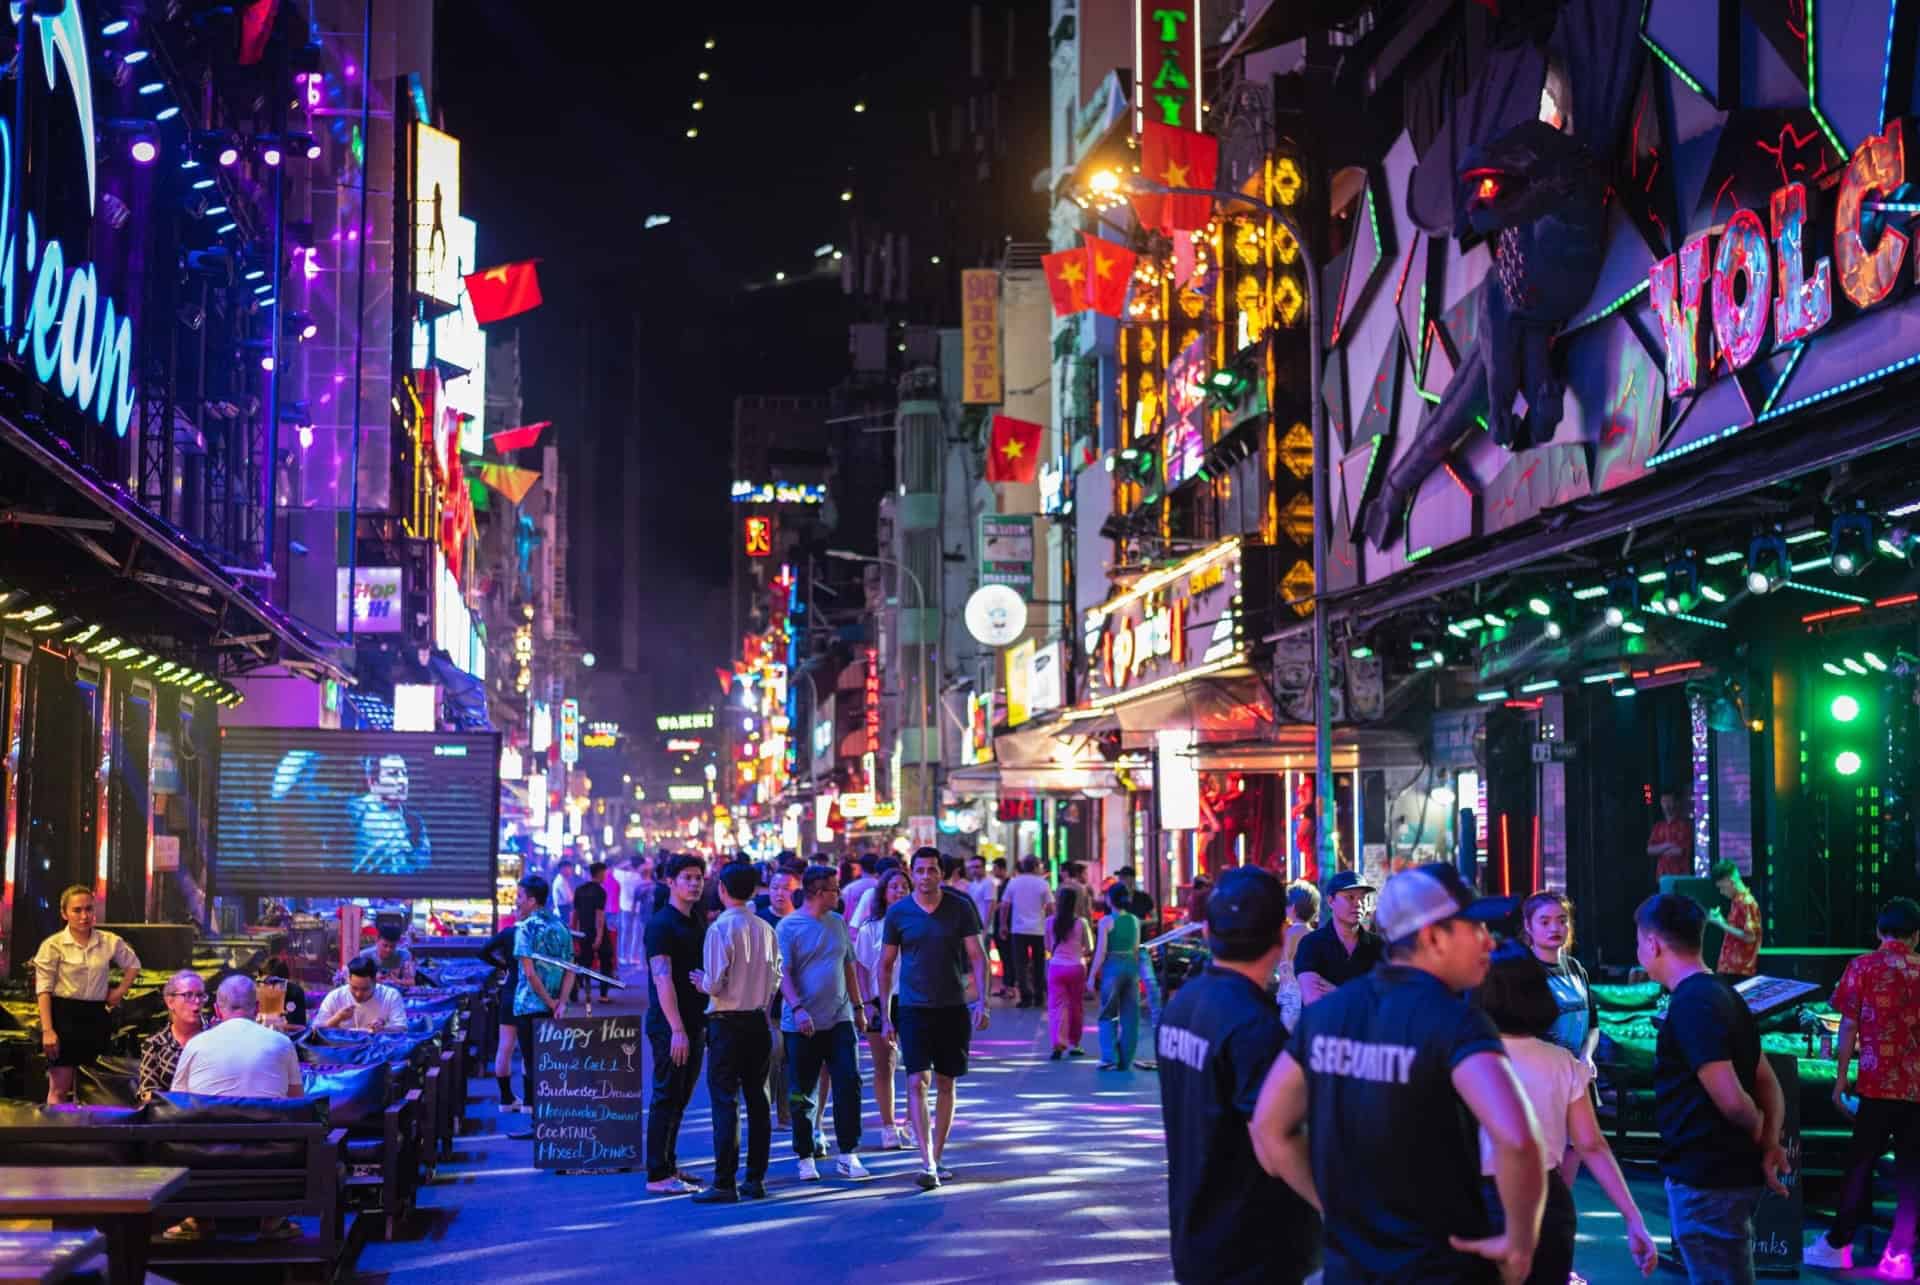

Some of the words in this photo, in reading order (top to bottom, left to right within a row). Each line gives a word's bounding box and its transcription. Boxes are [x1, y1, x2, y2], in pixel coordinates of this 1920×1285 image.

[1649, 118, 1920, 398] VOLC
[969, 303, 995, 402] HOTEL
[537, 1023, 594, 1051] Happy
[601, 1018, 639, 1043] Hour
[1158, 1023, 1210, 1073] ECURITY
[1309, 1034, 1417, 1085] SECURITY
[537, 1079, 598, 1099] Budweiser
[538, 1052, 569, 1080] Buy
